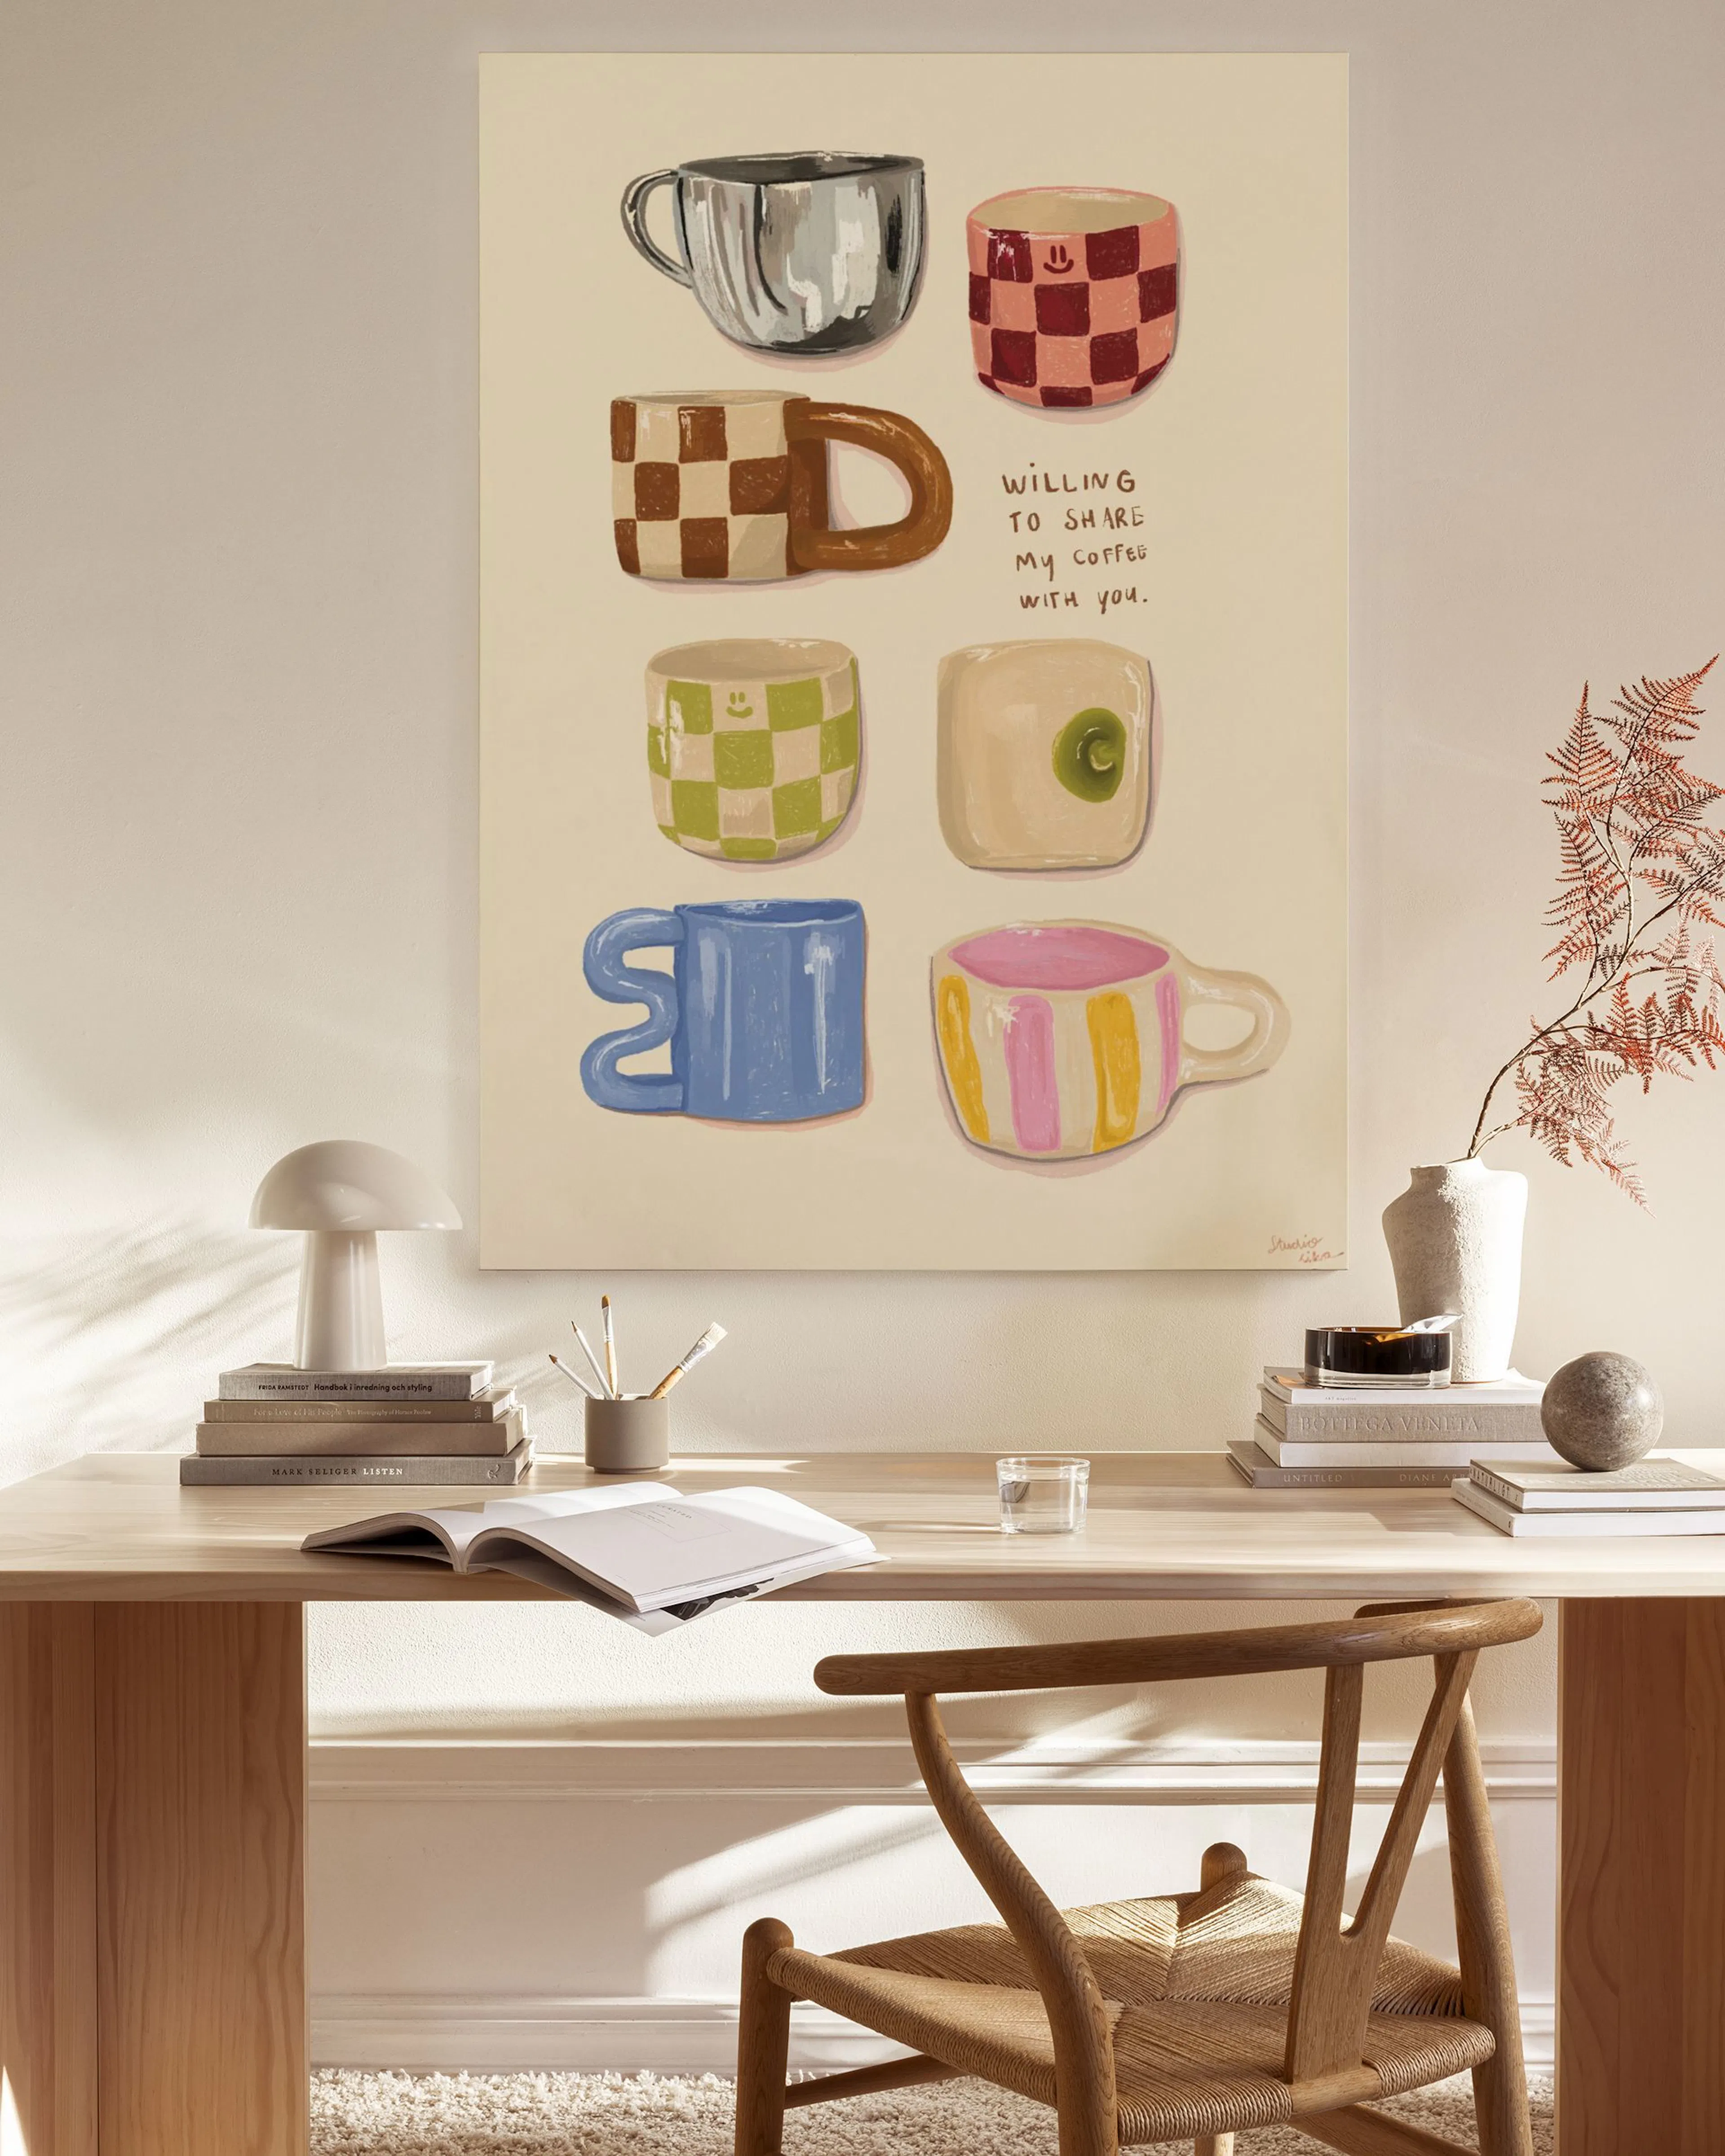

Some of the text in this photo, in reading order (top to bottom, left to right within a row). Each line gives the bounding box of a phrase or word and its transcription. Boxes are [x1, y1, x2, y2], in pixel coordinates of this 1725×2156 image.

[1009, 506, 1144, 533] TO SHARE
[1073, 543, 1147, 566] COFFEE
[1020, 592, 1079, 609] WITH
[1268, 1234, 1324, 1254] Studio
[354, 1383, 390, 1392] inredning
[407, 1383, 433, 1392] styling
[1300, 1417, 1479, 1431] BOTTEGA VENETA
[1283, 1474, 1343, 1483] UNTITLED
[1399, 1474, 1436, 1482] DIANE
